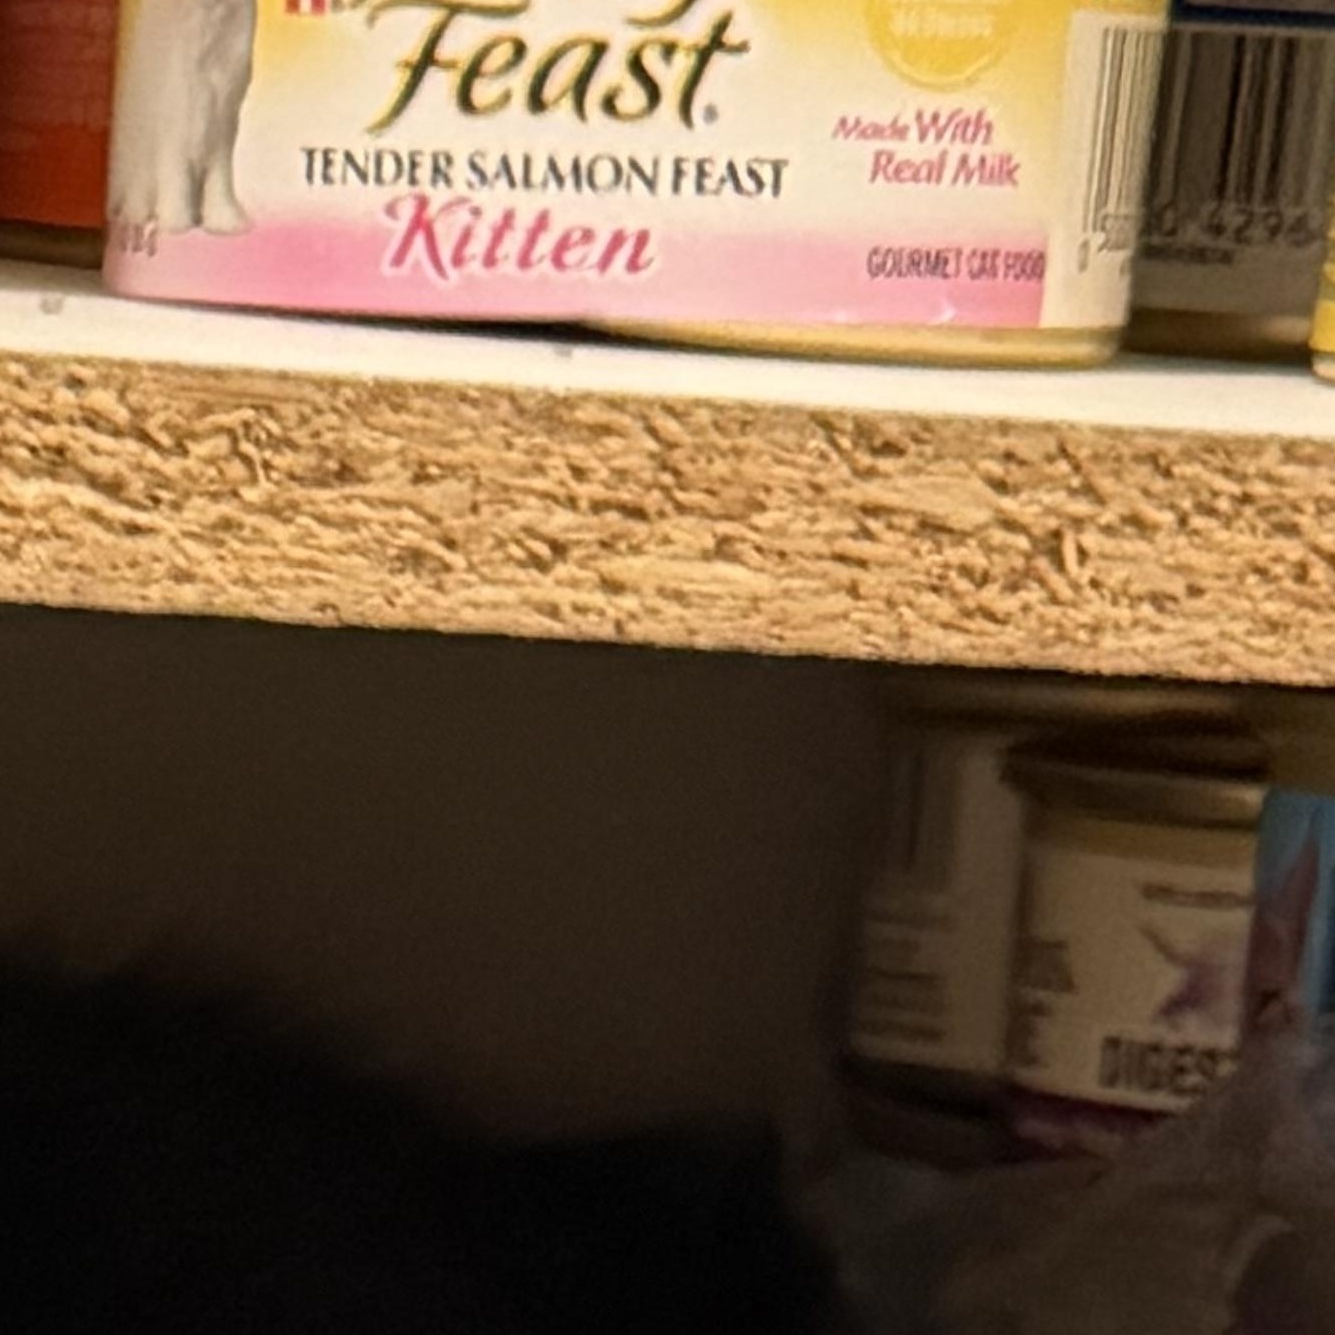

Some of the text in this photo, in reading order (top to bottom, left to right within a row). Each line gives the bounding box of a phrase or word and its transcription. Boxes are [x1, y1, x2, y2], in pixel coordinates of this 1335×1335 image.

[363, 0, 752, 136] Feast
[831, 106, 994, 146] Made With
[299, 146, 790, 199] TENDER SALMON FEAST
[868, 149, 1022, 187] Real Milk
[382, 192, 657, 282] Kitten
[865, 246, 963, 280] GOURMET
[965, 249, 1000, 281] CAT
[1002, 250, 1046, 283] FOOD
